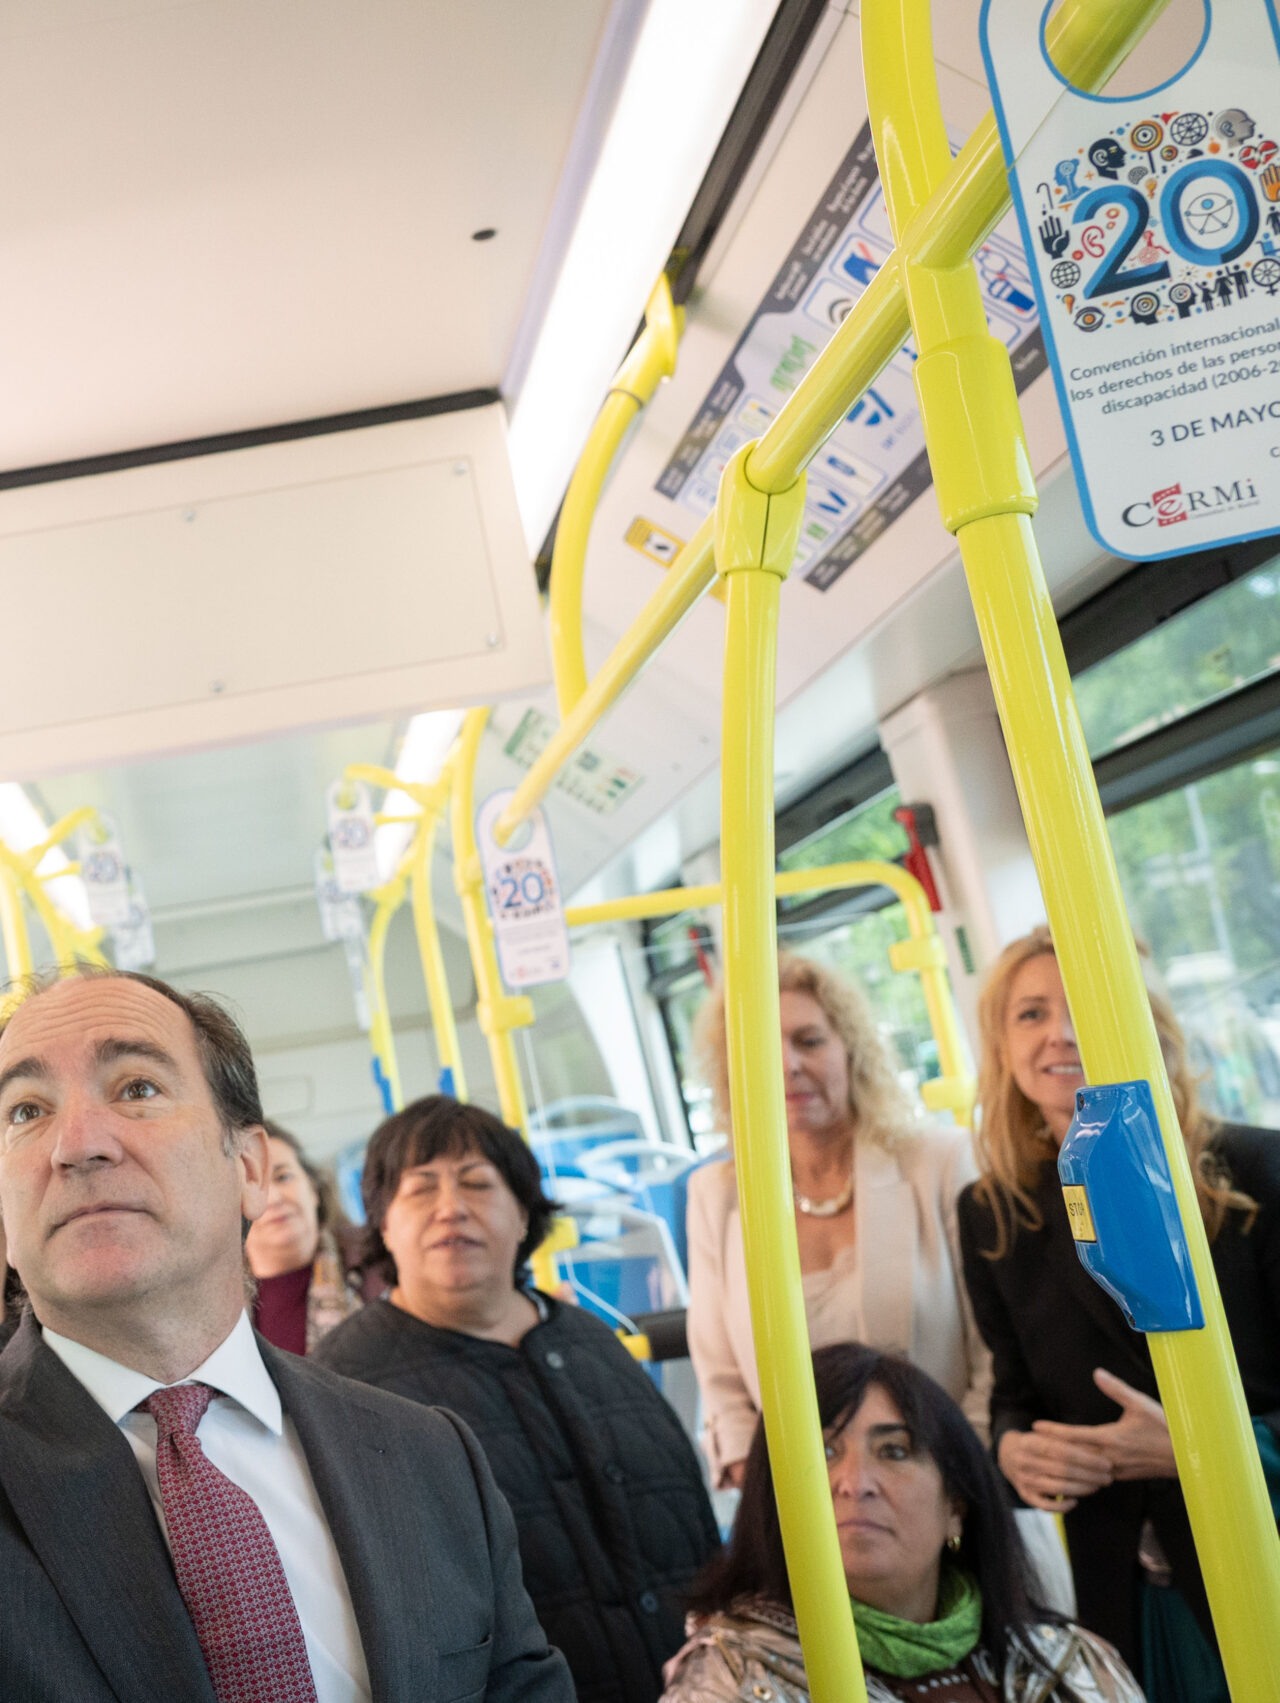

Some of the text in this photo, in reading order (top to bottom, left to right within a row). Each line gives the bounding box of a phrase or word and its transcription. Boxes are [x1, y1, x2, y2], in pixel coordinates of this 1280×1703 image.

[1071, 158, 1260, 300] 20
[1070, 348, 1168, 381] Convención
[1170, 317, 1280, 357] internacional
[1070, 342, 1280, 402] los derechos de las perso
[1101, 359, 1280, 415] discapacidad (2006-2
[1150, 429, 1166, 447] 3
[1171, 419, 1205, 442] DE
[500, 872, 544, 909] 20
